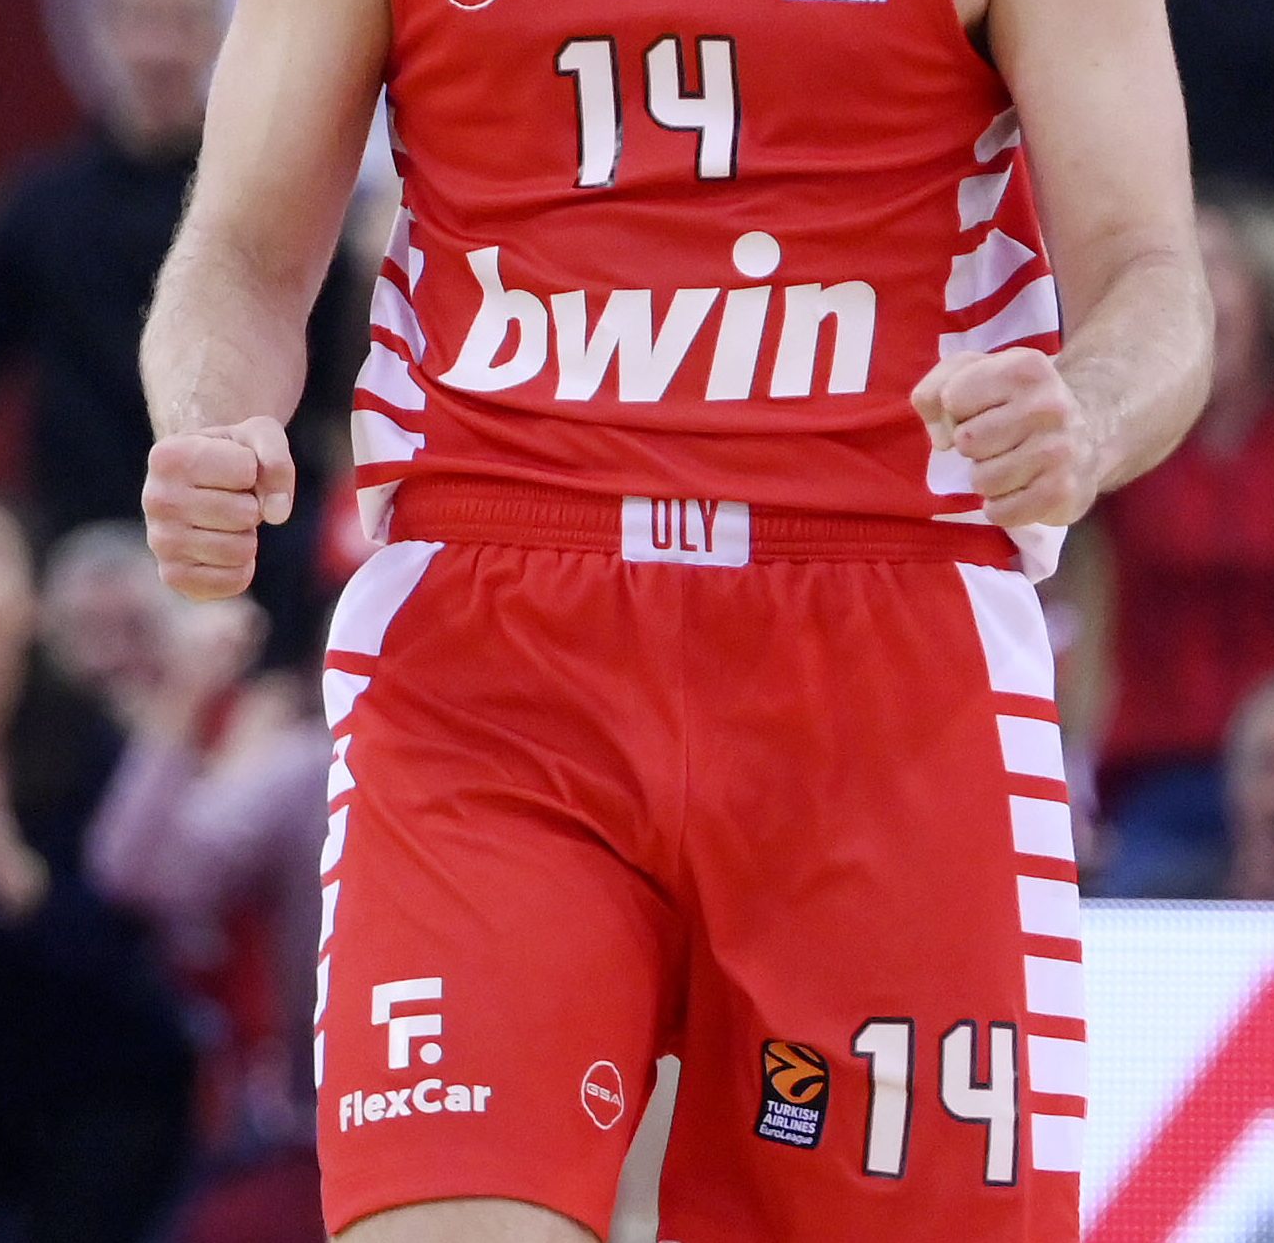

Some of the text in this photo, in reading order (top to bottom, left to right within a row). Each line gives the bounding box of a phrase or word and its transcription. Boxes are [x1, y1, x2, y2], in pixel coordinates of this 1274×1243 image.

[555, 34, 741, 189] 14
[438, 232, 878, 403] bwin
[338, 1078, 492, 1133] FlexCar
[586, 1082, 622, 1107] GSA
[766, 1100, 820, 1122] TURKISH
[850, 1017, 1019, 1187] 14
[762, 1112, 817, 1134] AIRLINES
